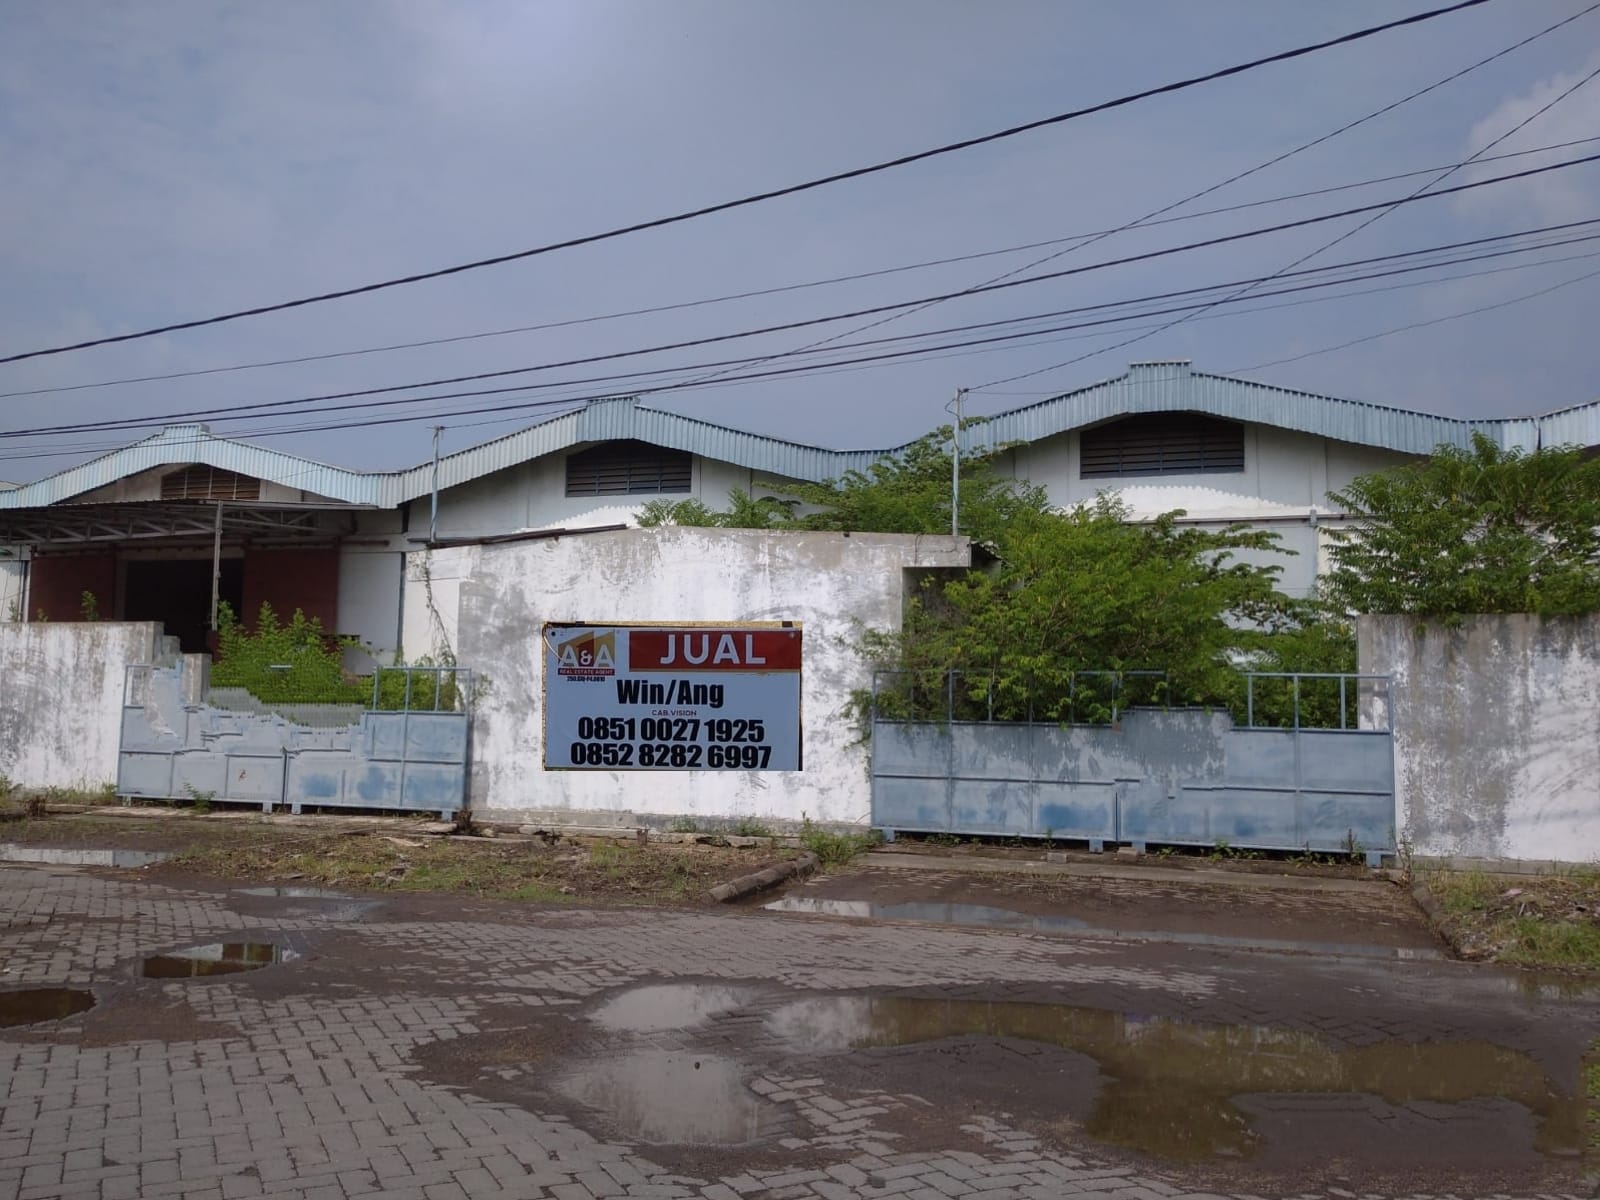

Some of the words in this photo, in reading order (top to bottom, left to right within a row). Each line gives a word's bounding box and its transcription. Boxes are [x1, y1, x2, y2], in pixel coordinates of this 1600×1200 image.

[558, 643, 615, 667] A&A
[659, 633, 766, 665] JUAL
[616, 679, 724, 709] Win/Ang
[578, 717, 636, 740] 0851
[640, 717, 700, 742] 0027
[704, 719, 765, 742] 1925
[570, 742, 633, 766] 0852
[638, 743, 702, 767] 8282
[707, 745, 772, 769] 6997
